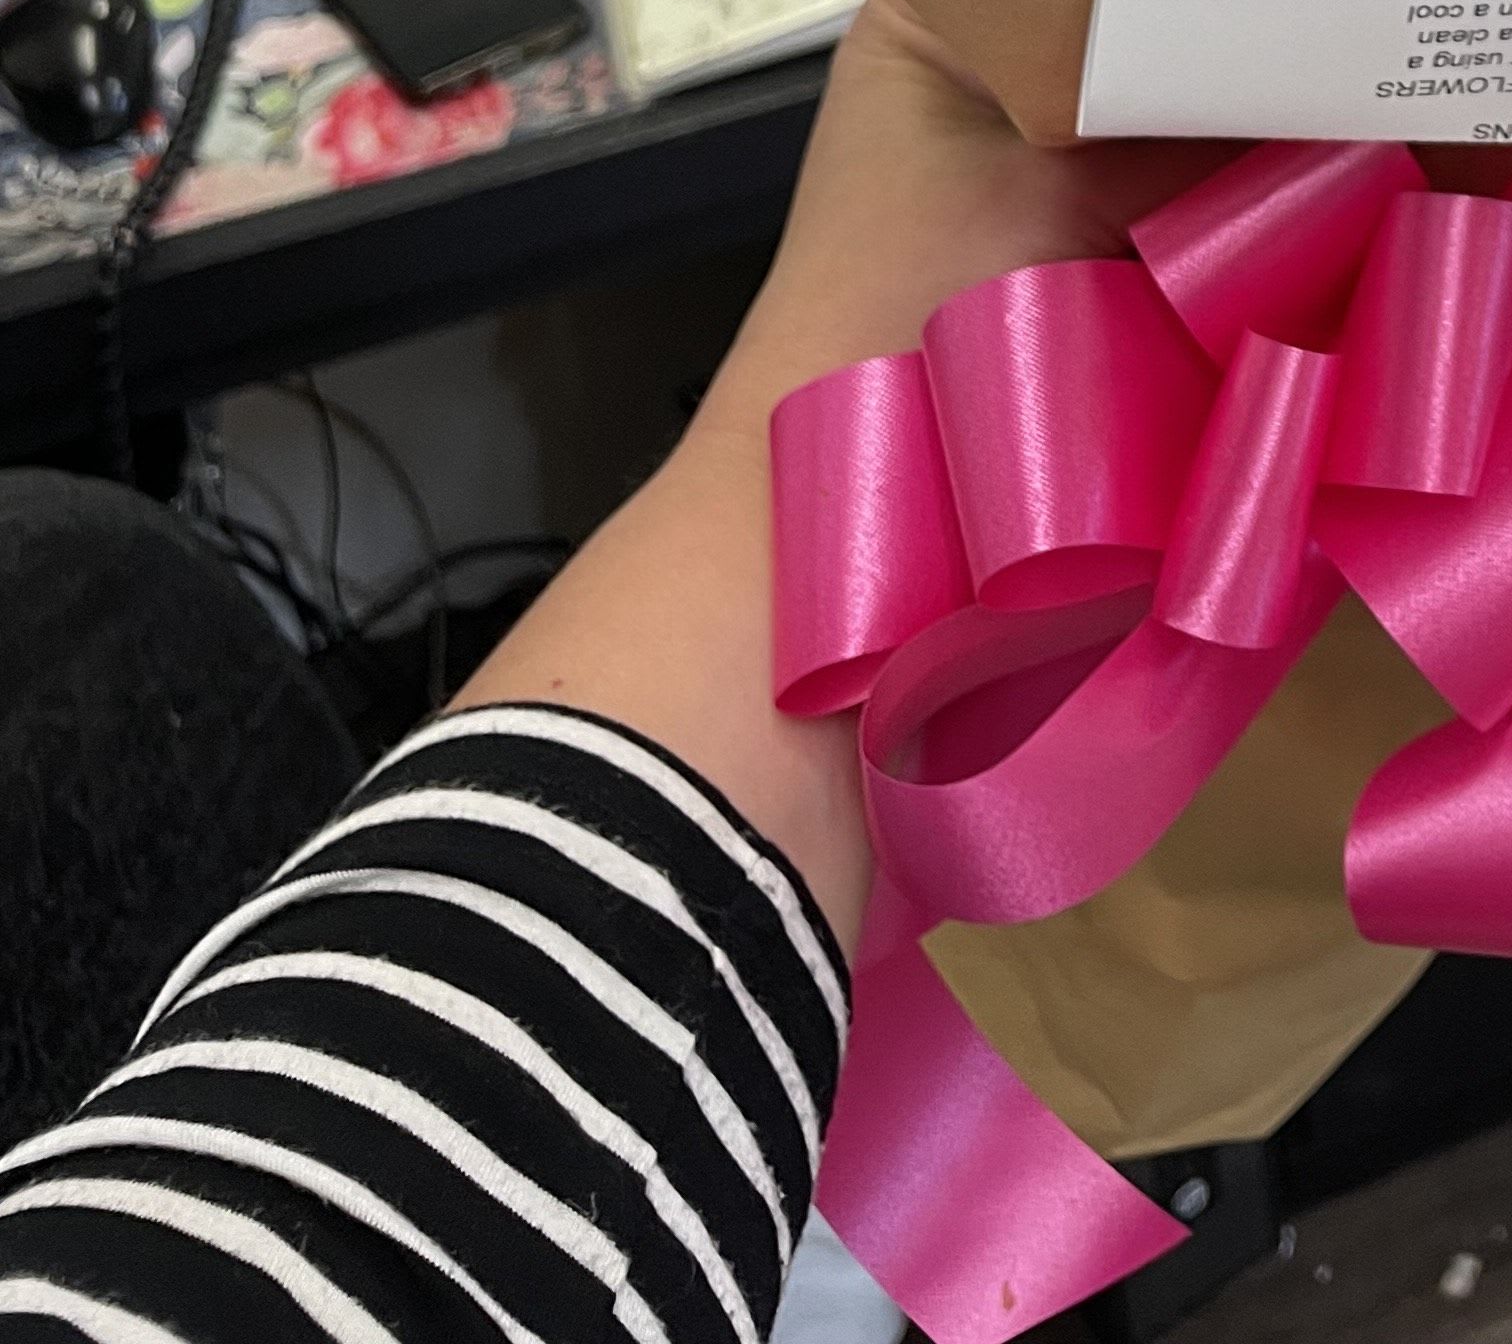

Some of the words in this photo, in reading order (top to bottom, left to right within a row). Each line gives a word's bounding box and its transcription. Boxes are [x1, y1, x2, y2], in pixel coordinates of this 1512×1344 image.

[1407, 4, 1464, 22] cool
[1474, 3, 1490, 18] a
[1418, 28, 1489, 46] clean
[1408, 56, 1424, 70] a
[1432, 51, 1504, 70] using
